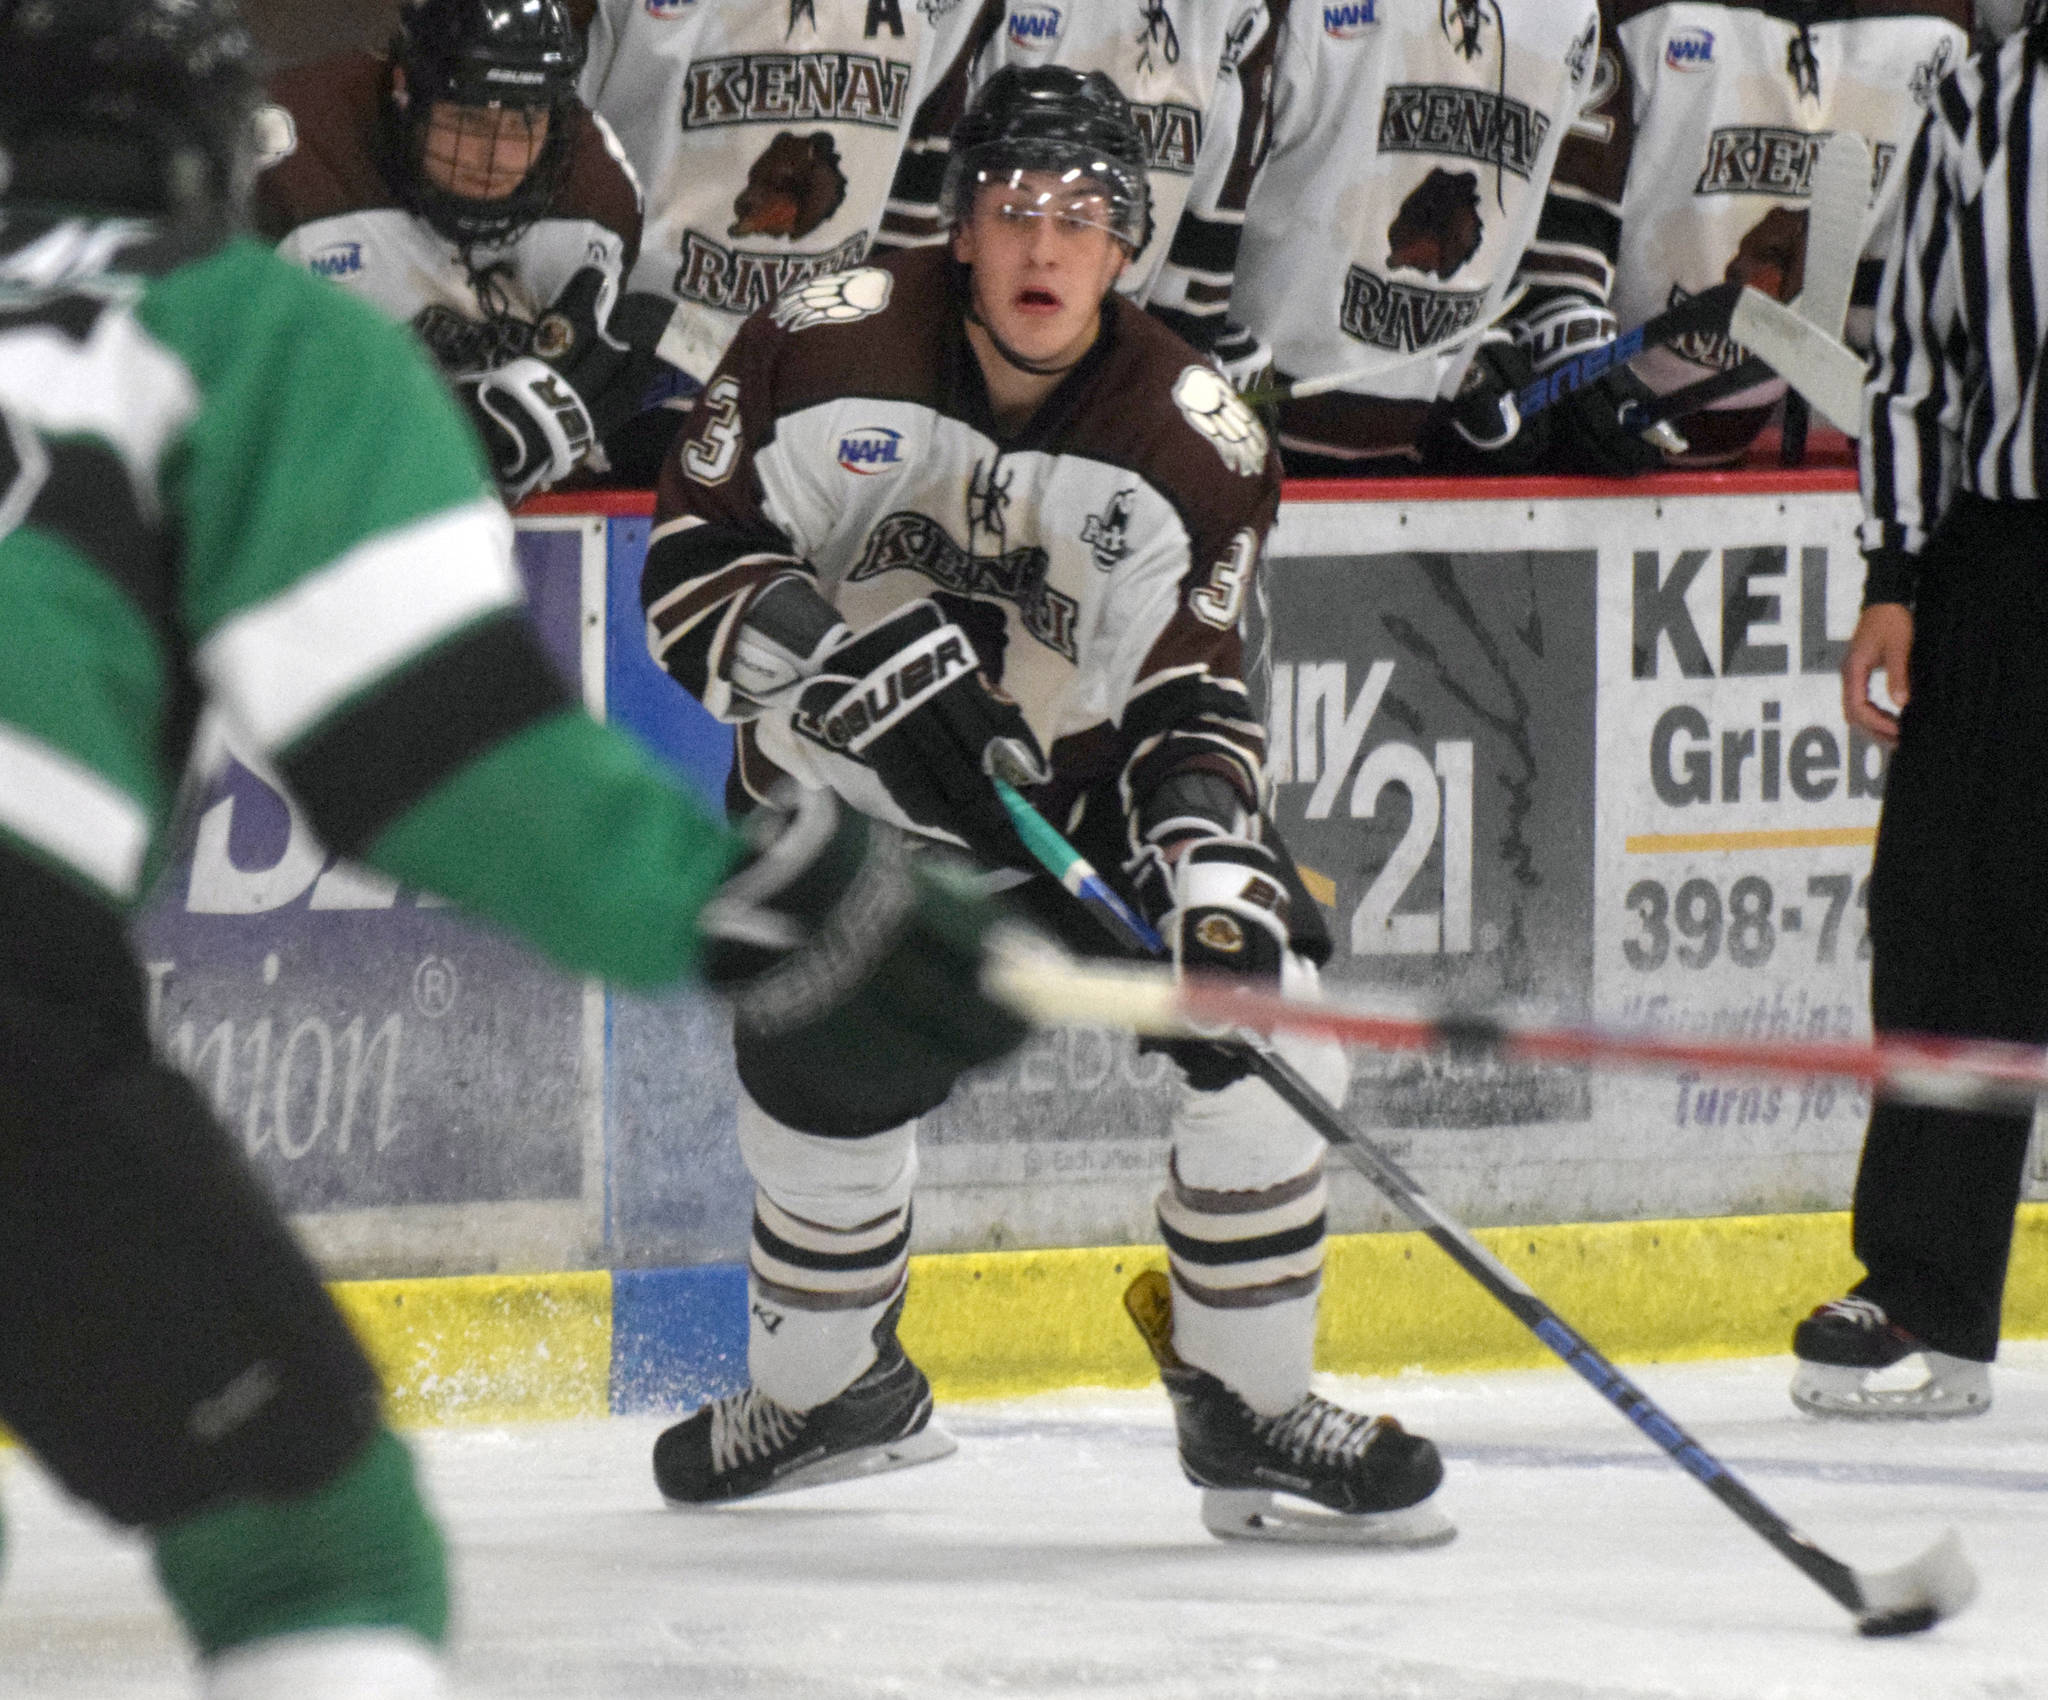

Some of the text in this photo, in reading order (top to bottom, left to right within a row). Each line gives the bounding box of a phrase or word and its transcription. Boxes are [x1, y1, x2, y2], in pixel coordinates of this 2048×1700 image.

[682, 53, 911, 131] KENAI
[681, 374, 742, 488] 3
[837, 437, 903, 464] NAHL
[1190, 527, 1257, 632] 3
[1632, 545, 1856, 681] KEL
[1650, 700, 1890, 808] Grieb
[1350, 740, 1474, 957] 21
